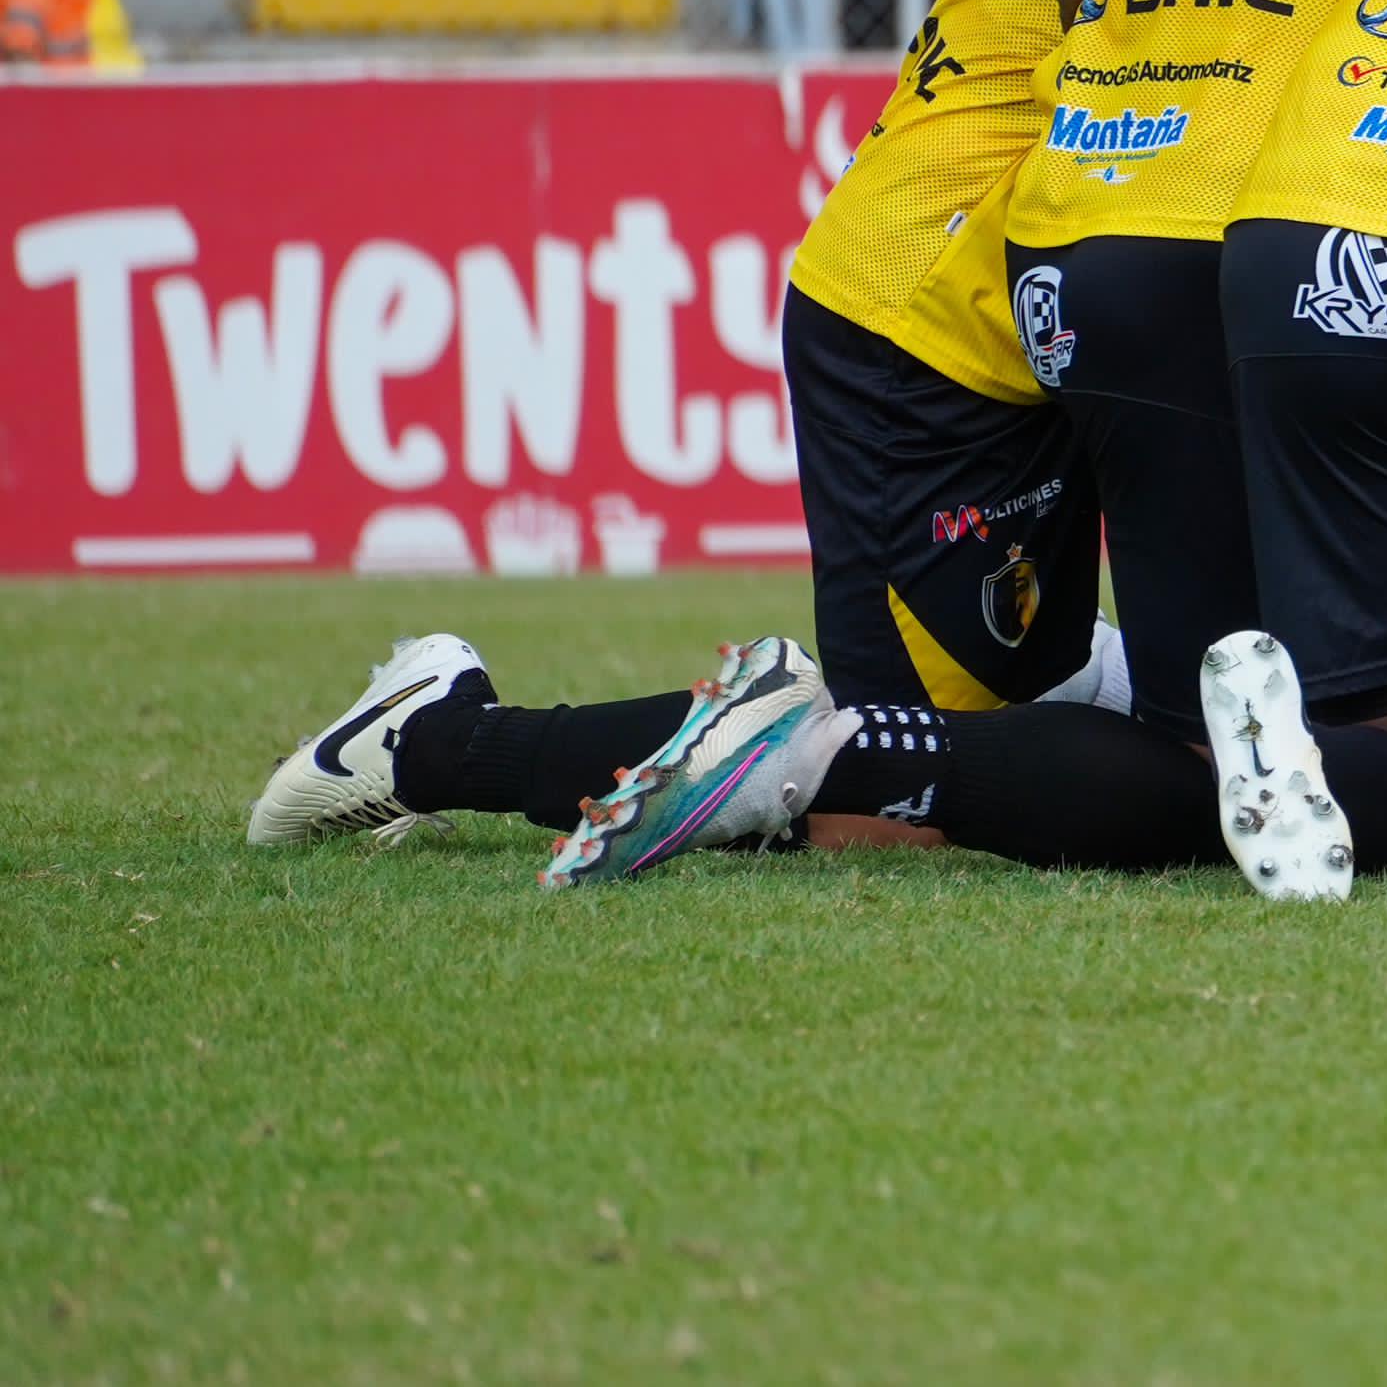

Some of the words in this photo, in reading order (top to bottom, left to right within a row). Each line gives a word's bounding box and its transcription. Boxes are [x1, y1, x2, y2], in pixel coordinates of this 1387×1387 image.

[1138, 59, 1255, 83] Automotriz
[1050, 107, 1187, 150] Montaña
[14, 198, 801, 497] Twenty
